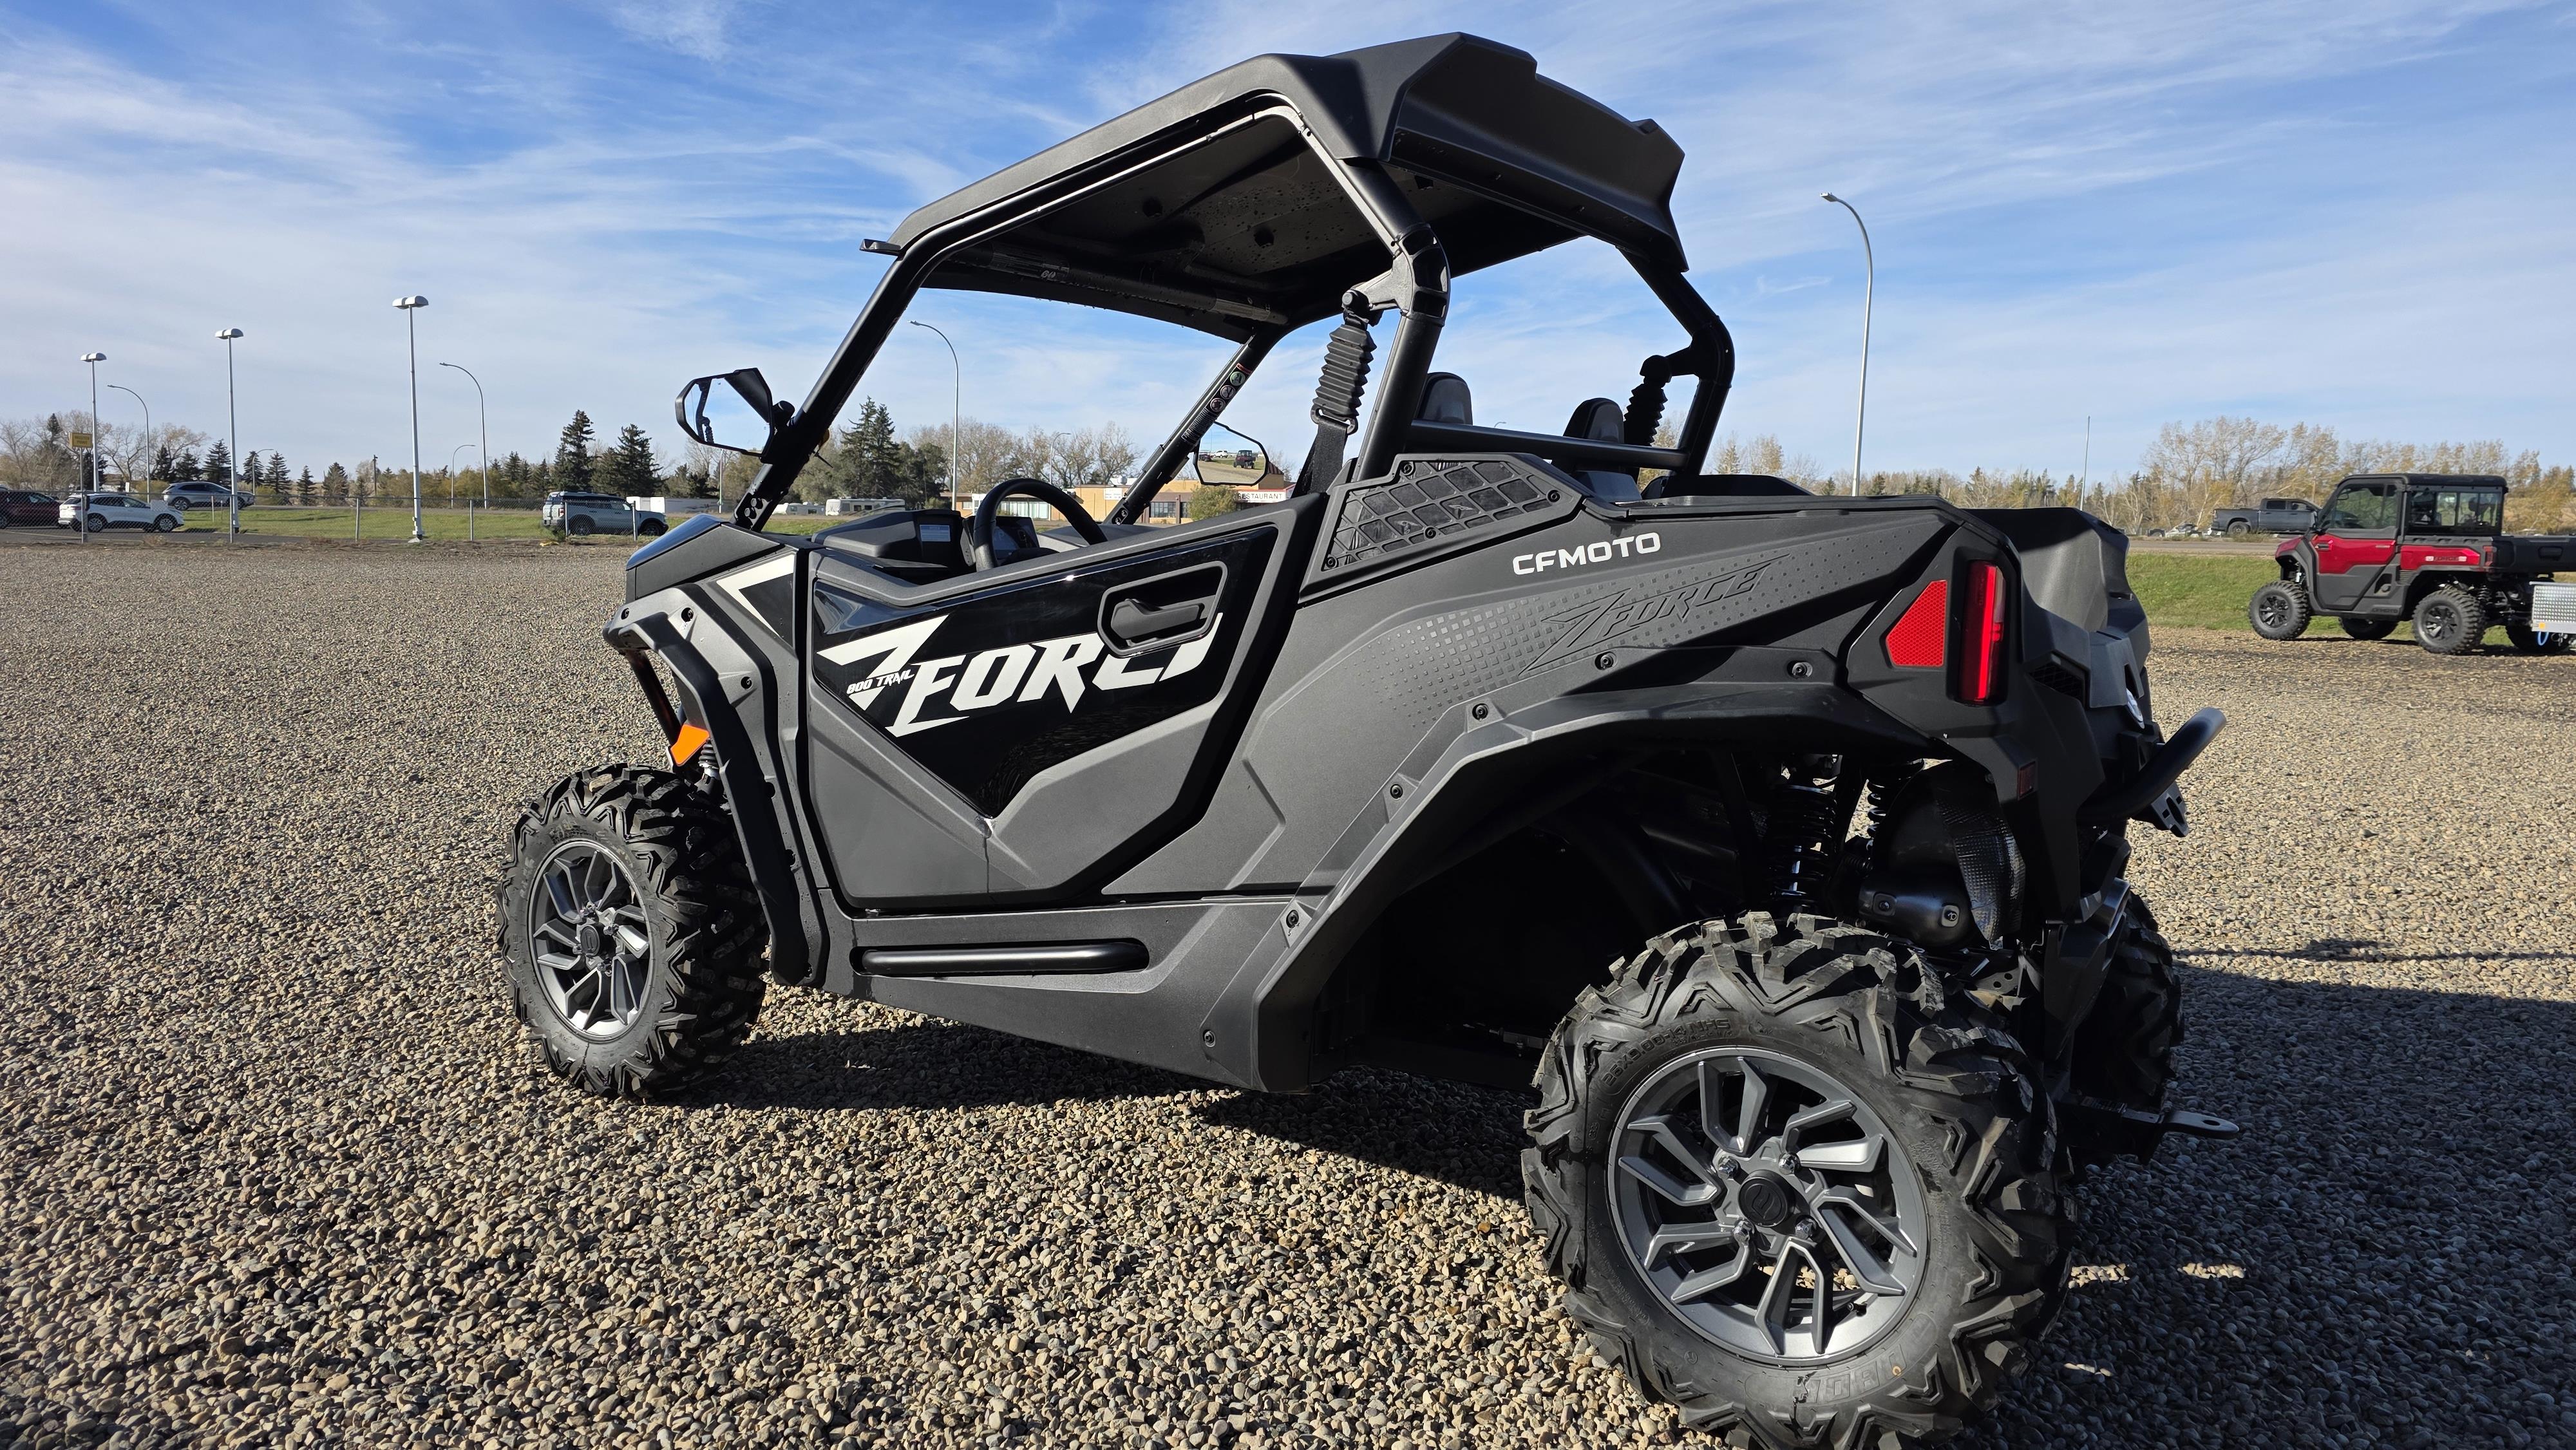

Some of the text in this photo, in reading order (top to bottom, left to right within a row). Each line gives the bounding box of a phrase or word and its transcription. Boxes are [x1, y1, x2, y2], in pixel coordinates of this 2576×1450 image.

[1512, 532, 1661, 576] CFMOTO
[846, 669, 915, 694] 800 TRAIL
